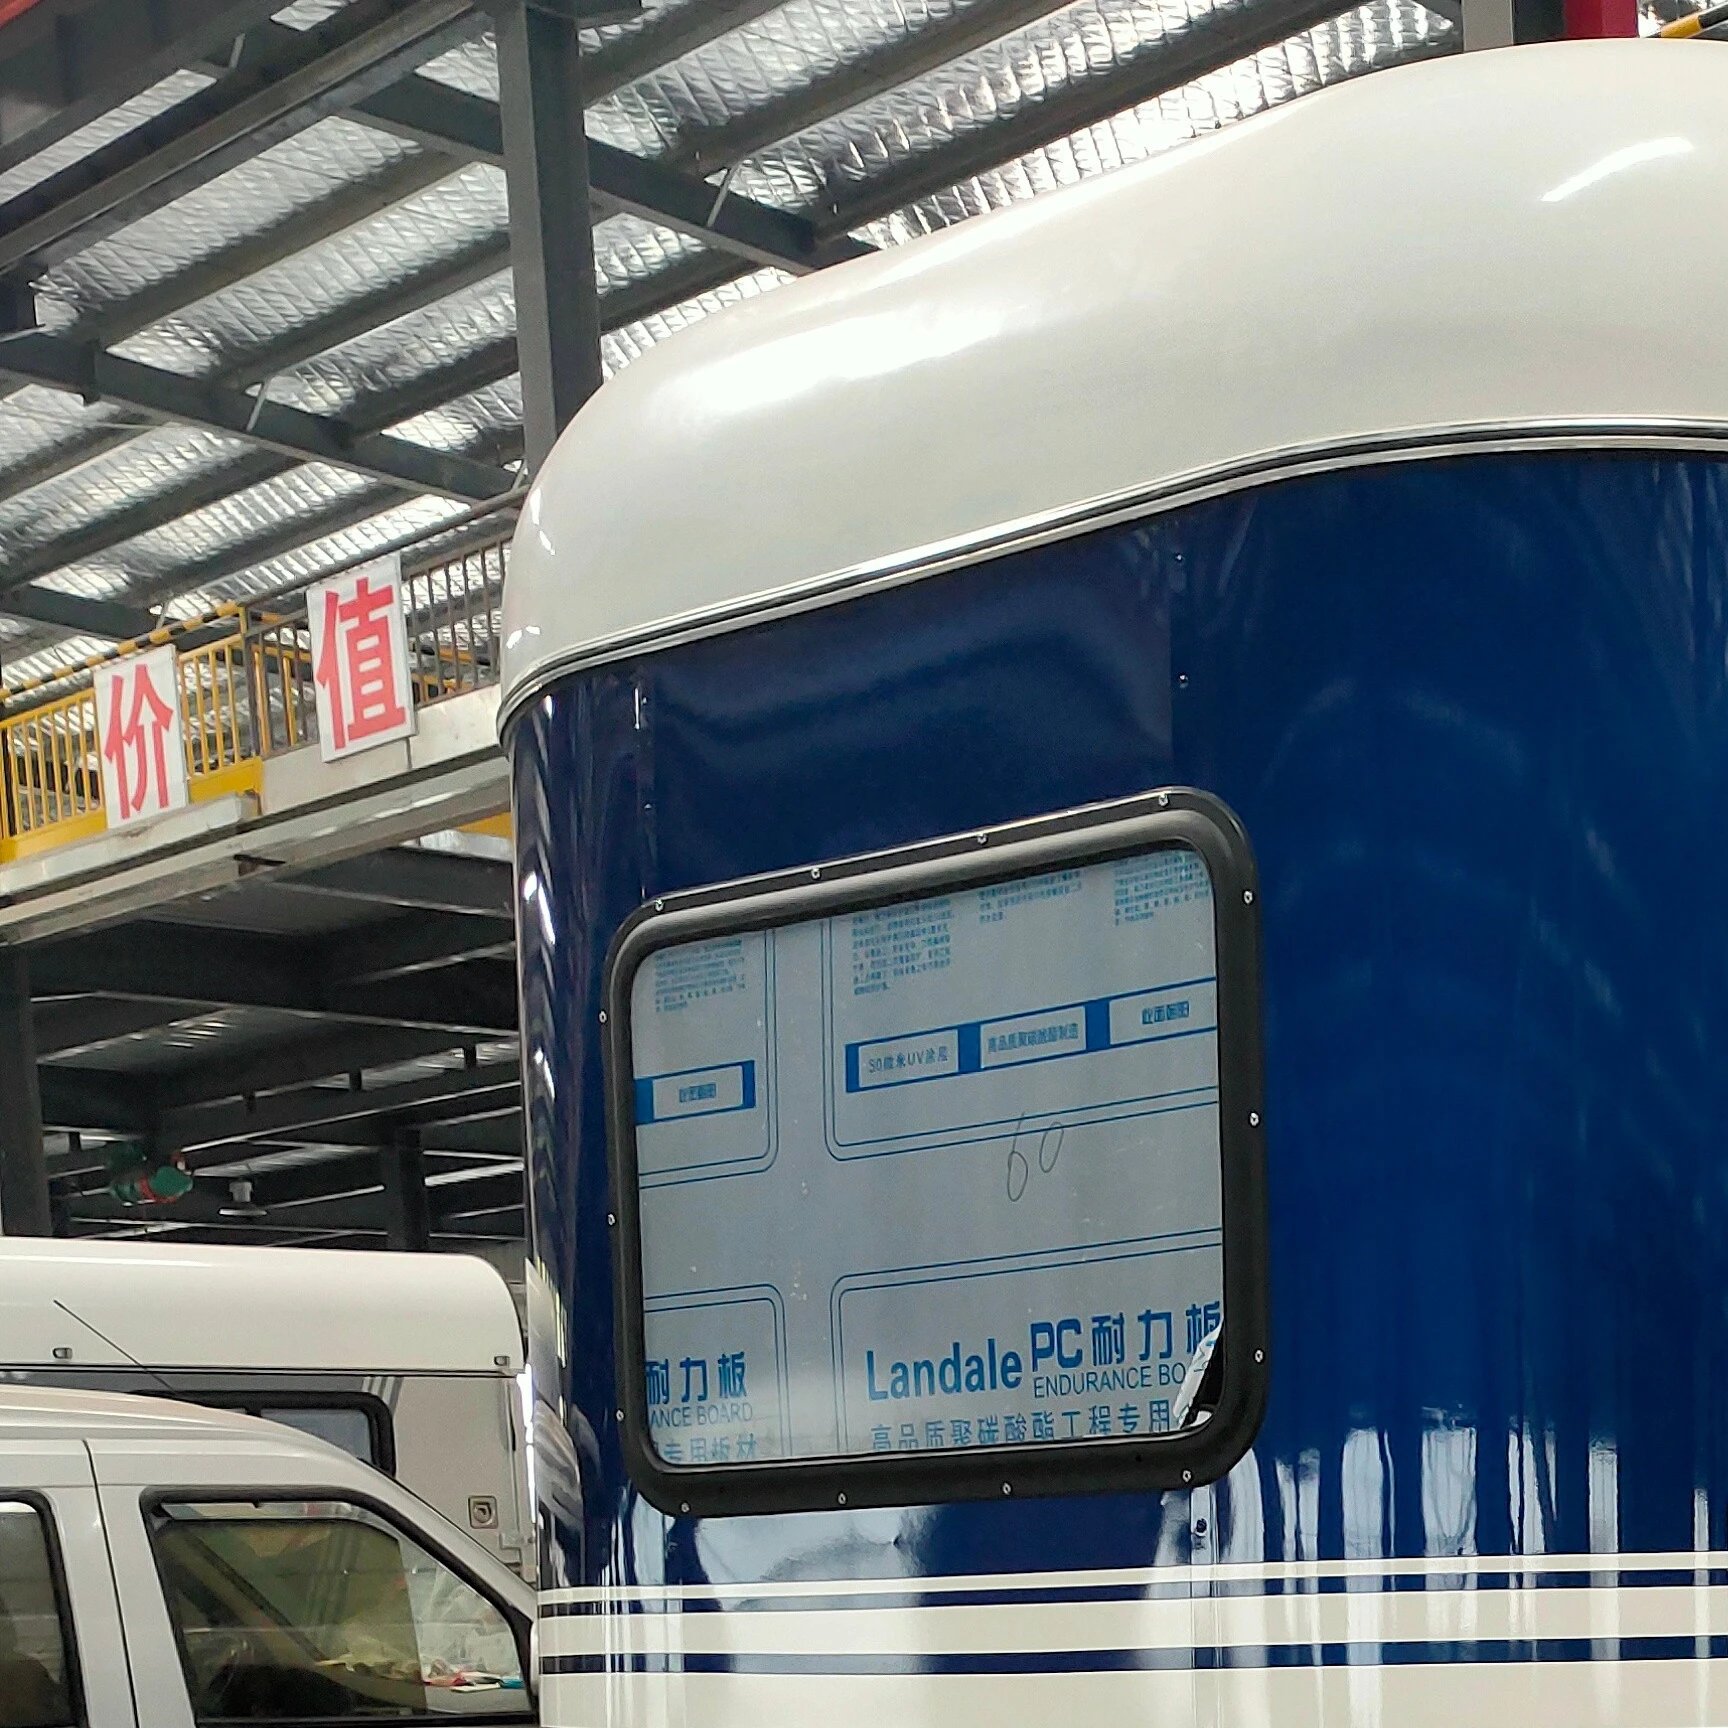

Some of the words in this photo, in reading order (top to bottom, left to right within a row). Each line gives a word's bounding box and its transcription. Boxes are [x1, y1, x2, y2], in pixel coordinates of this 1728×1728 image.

[317, 577, 405, 750] 值
[104, 664, 174, 819] 价
[1007, 1111, 1064, 1202] 60
[646, 1351, 747, 1404] 耐力板
[866, 1338, 1022, 1400] Landale
[1034, 1365, 1152, 1399] ENDURANCE
[650, 1406, 692, 1429] ANCE
[697, 1402, 753, 1425] BOARD
[652, 1433, 757, 1461] 专用板材
